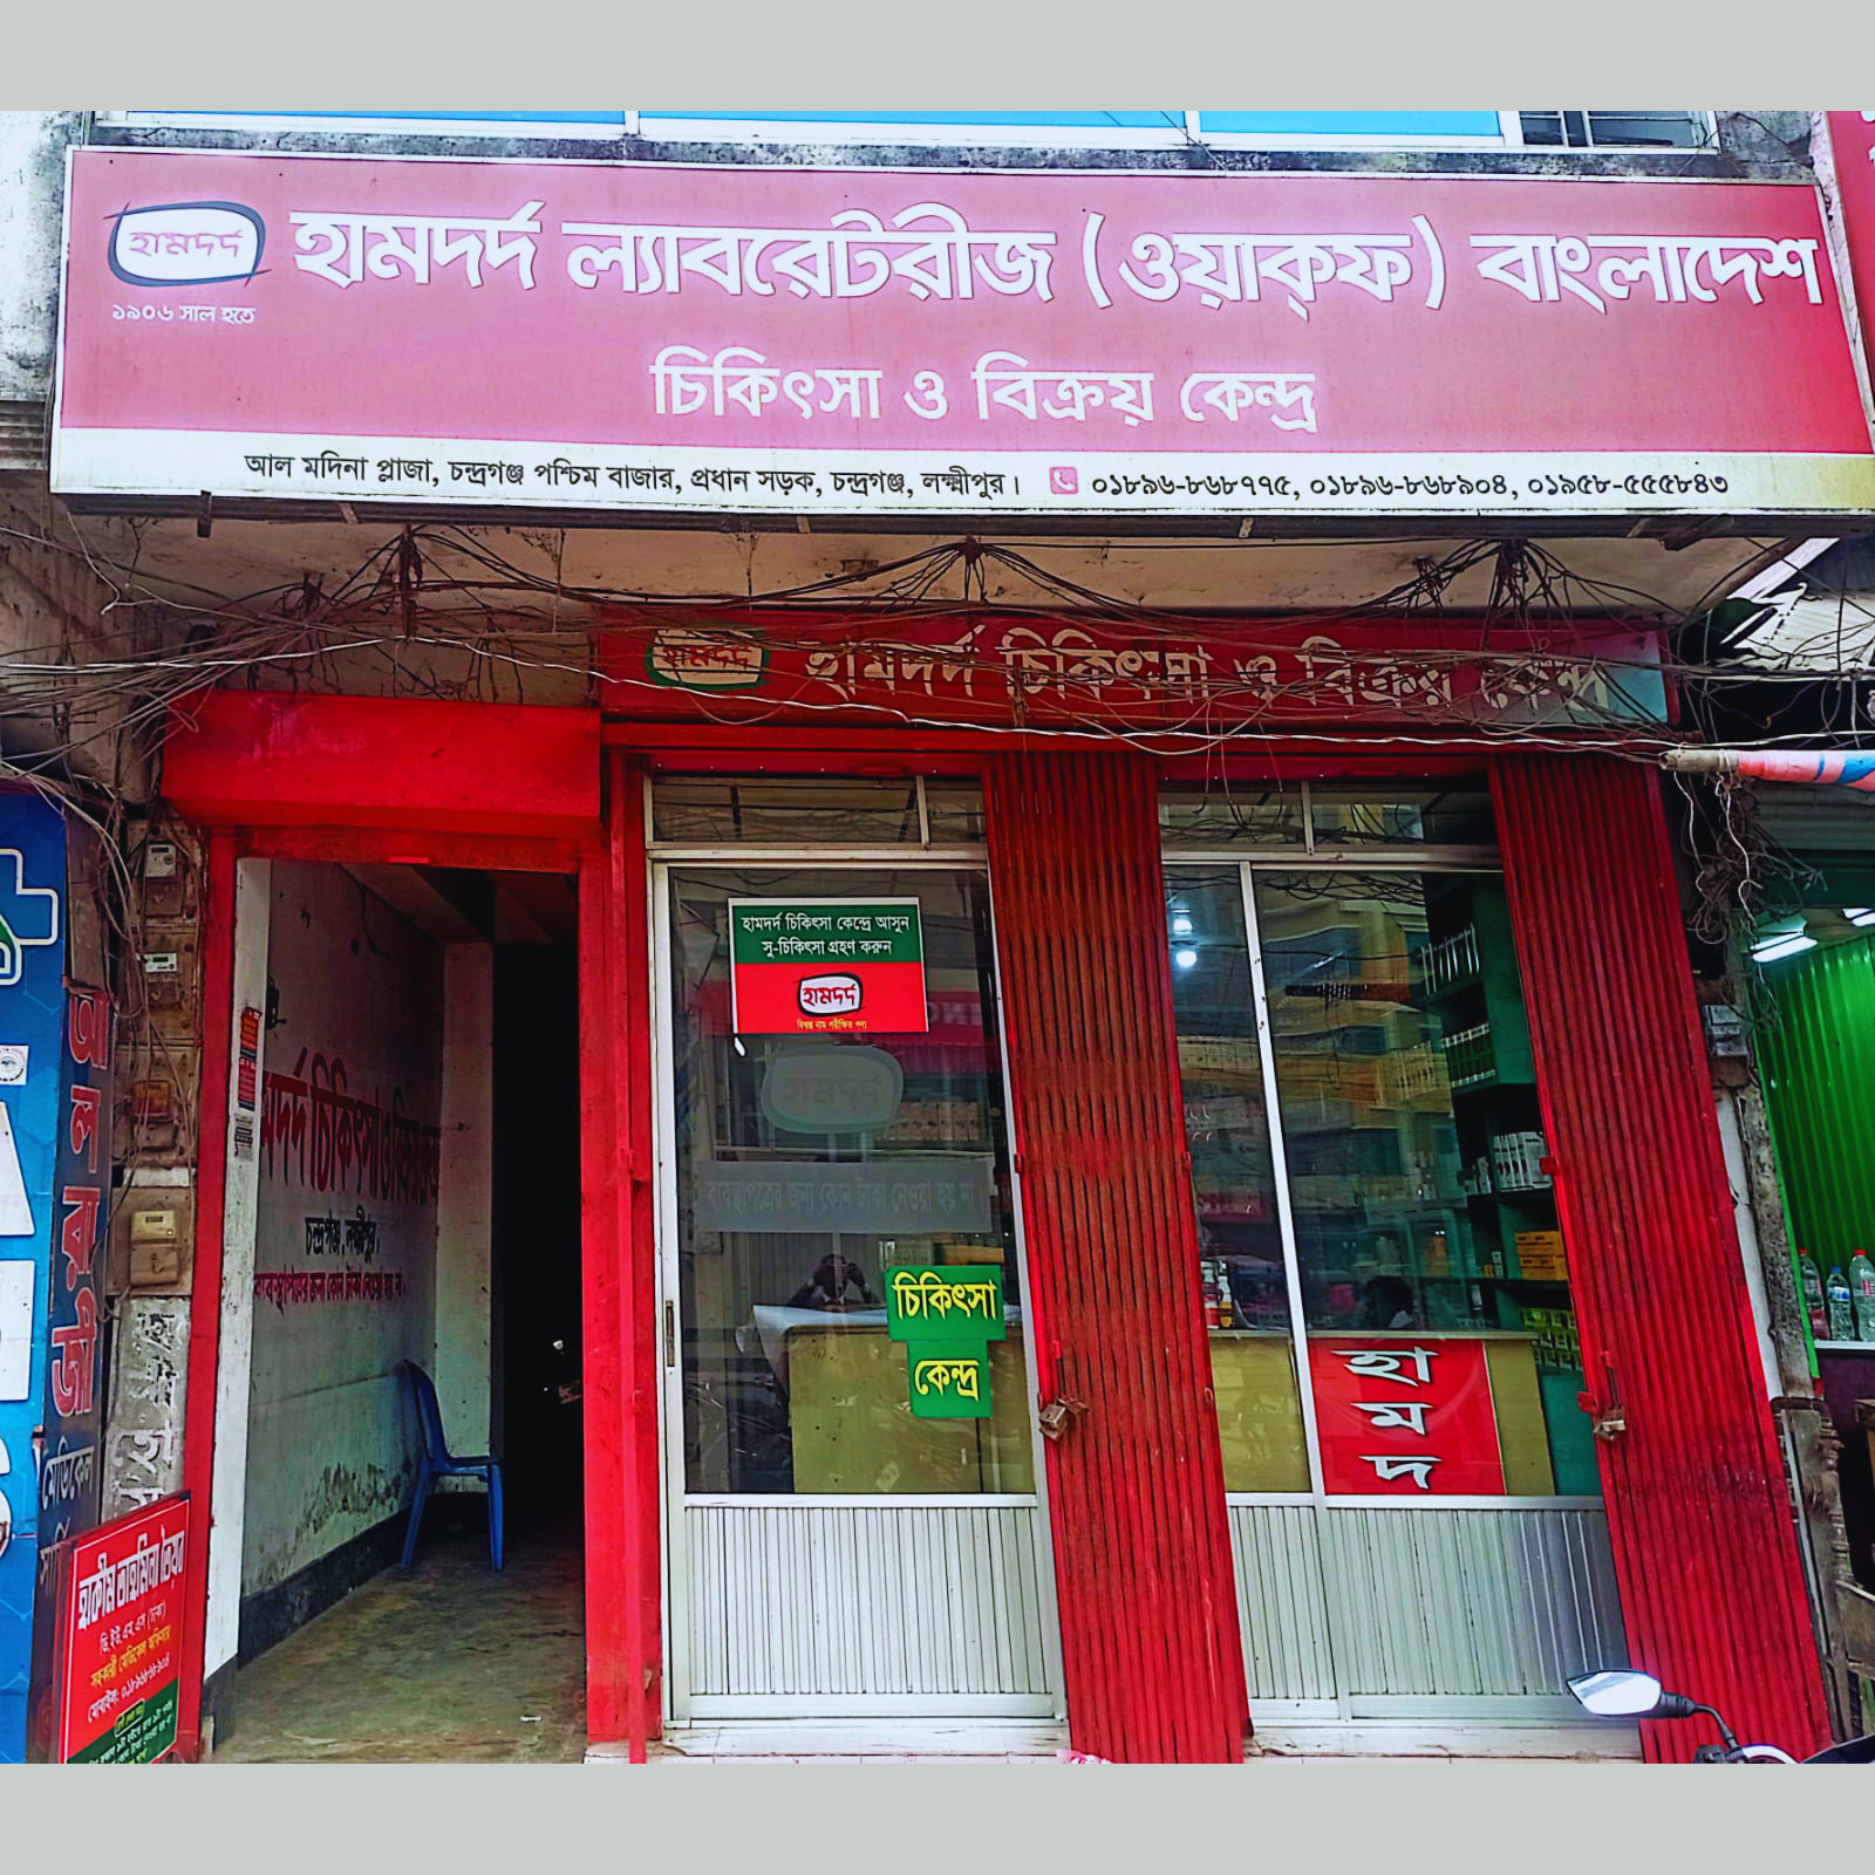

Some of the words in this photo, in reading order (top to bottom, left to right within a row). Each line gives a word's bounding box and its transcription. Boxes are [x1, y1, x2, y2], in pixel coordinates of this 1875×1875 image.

[128, 229, 243, 258] হামদর্দ
[290, 200, 546, 290] হামদর্দ
[561, 201, 1058, 303] ল্যাবরেটরীজ
[1469, 233, 1823, 316] বাংলাদেশ
[112, 304, 174, 323] ১৯০৬
[179, 304, 216, 324] সাল
[220, 306, 256, 326] হতে
[649, 344, 884, 420] চিকিৎসা
[903, 370, 949, 421] ও
[970, 351, 1154, 427] বিক্রয়
[1180, 373, 1318, 433] কেন্দ্র
[244, 453, 296, 479] আল
[301, 449, 366, 482] মদিনা
[376, 458, 440, 489] প্লাজা,
[448, 458, 525, 488] চন্দ্রগঞ্জ
[534, 457, 600, 488] পশ্চিম
[607, 464, 682, 494] বাজার,
[690, 466, 749, 492] প্রধান
[757, 468, 822, 496] সড়ক,
[828, 470, 914, 499] চন্দ্রগঞ্জ,
[1091, 474, 1300, 501] ০১৮৯৬-৮৬৮৭৭৫,
[1309, 475, 1519, 500] ০১৮৯৬-৮৬৮৯০৪,
[1528, 474, 1729, 495] ০১৯৫৮-৫৫৫৮৪৩
[741, 912, 783, 933] হামদর্দ
[785, 912, 832, 931] চিকিৎসা
[837, 916, 871, 931] কেন্দ্রে
[875, 915, 910, 933] আসুন
[761, 937, 825, 958] সু-চিকিৎসা
[827, 940, 856, 956] গ্রহণ
[859, 940, 892, 956] করুন
[803, 983, 857, 1006] হামদর্দ
[261, 1045, 308, 1187] মদর্দ
[892, 1271, 997, 1320] চিকিৎসা
[914, 1359, 980, 1402] কেন্দ্র
